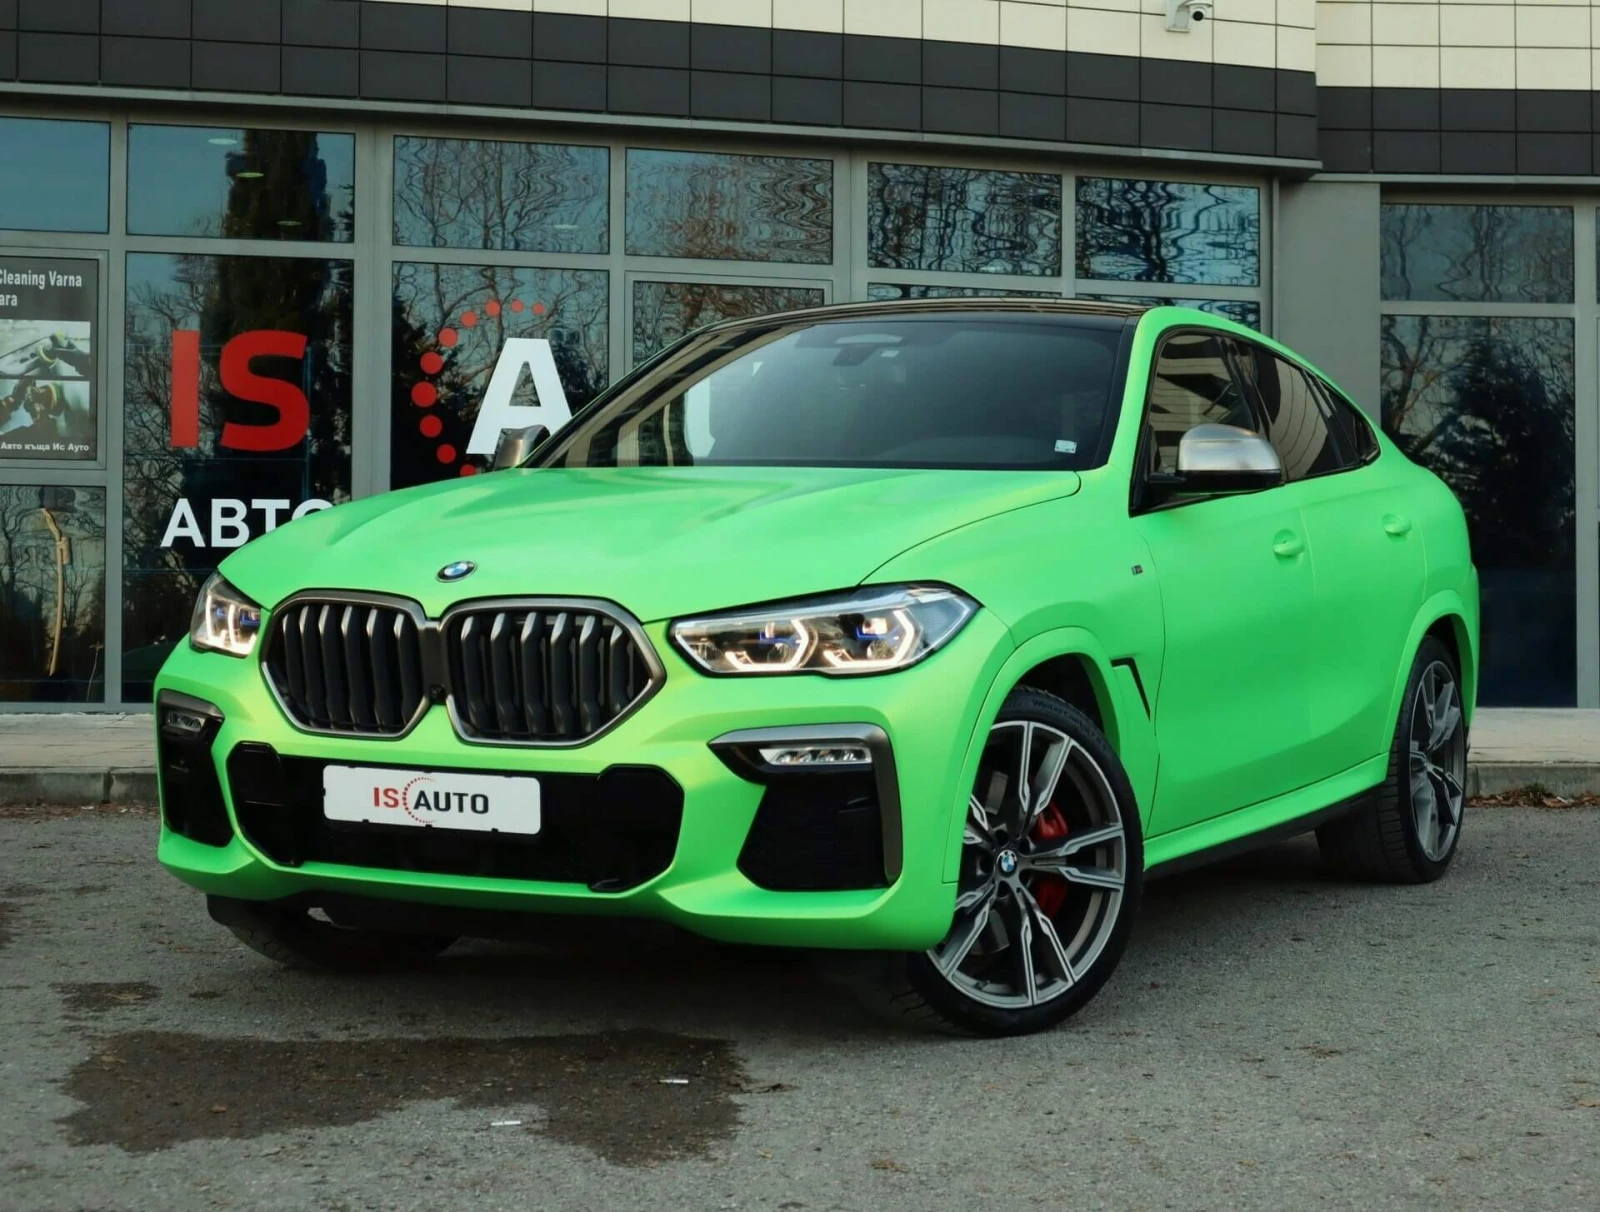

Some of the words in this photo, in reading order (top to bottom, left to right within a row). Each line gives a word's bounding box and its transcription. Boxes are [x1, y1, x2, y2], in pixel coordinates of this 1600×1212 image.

[48, 270, 82, 287] Varna
[171, 329, 310, 451] IS
[0, 441, 22, 450] Авто
[24, 443, 50, 451] къща
[52, 442, 66, 451] Ис
[67, 443, 90, 453] Ауто
[373, 787, 399, 808] IS
[413, 790, 489, 814] AUTO
